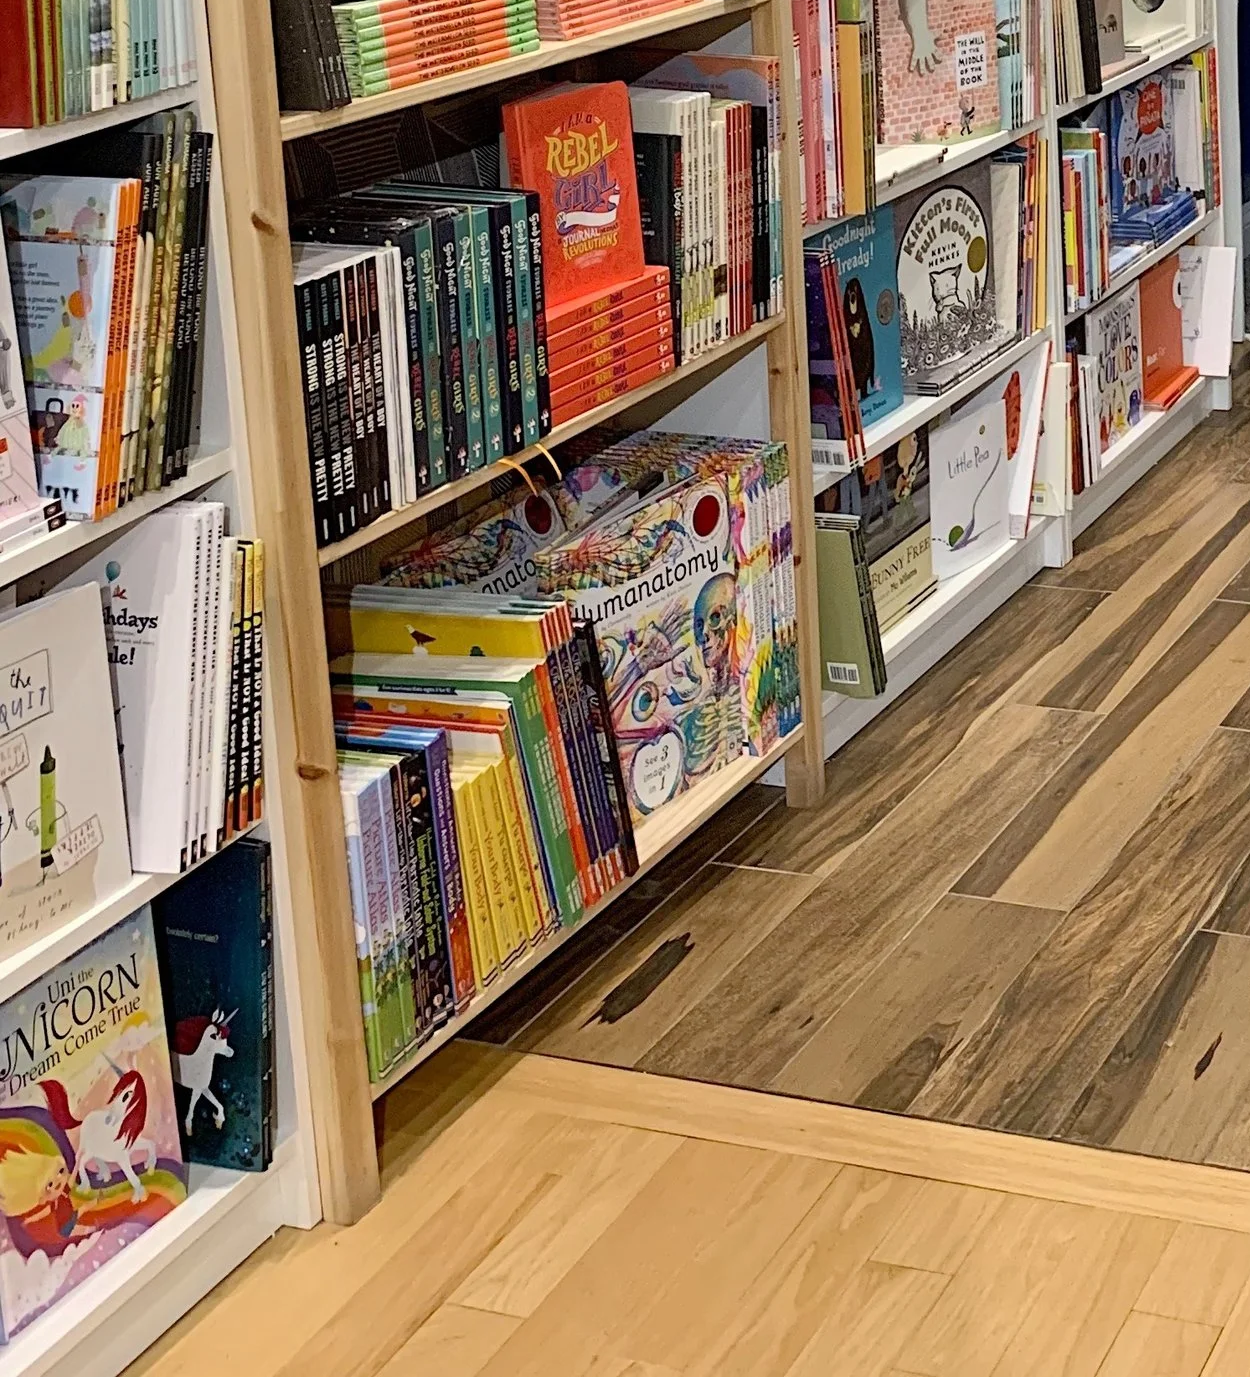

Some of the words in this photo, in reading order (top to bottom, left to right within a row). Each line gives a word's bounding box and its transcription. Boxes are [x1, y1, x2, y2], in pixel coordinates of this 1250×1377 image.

[957, 39, 968, 48] THE
[969, 35, 984, 47] WALL
[958, 54, 984, 68] MIDDLE
[960, 74, 983, 86] BOOK
[545, 121, 618, 177] REBEL
[822, 217, 876, 255] Goodnight
[903, 198, 951, 256] Kitten's
[955, 196, 981, 228] First
[915, 226, 936, 264] Full
[940, 217, 972, 245] Moon
[836, 242, 875, 276] lready!
[928, 250, 960, 269] HENKES
[931, 242, 957, 257] KEVIN
[305, 343, 318, 393] STRONG
[315, 458, 328, 503] PRETTY
[322, 339, 334, 387] STRONG
[331, 452, 344, 497] PRETTY
[334, 333, 346, 381] STRONG
[343, 446, 356, 490] PRETTY
[948, 452, 973, 479] Little
[974, 446, 990, 468] Pea
[48, 971, 76, 1004] Uni
[78, 967, 94, 984] the
[9, 1051, 61, 1096] Dream
[64, 1019, 106, 1057] Come
[108, 996, 141, 1027] True
